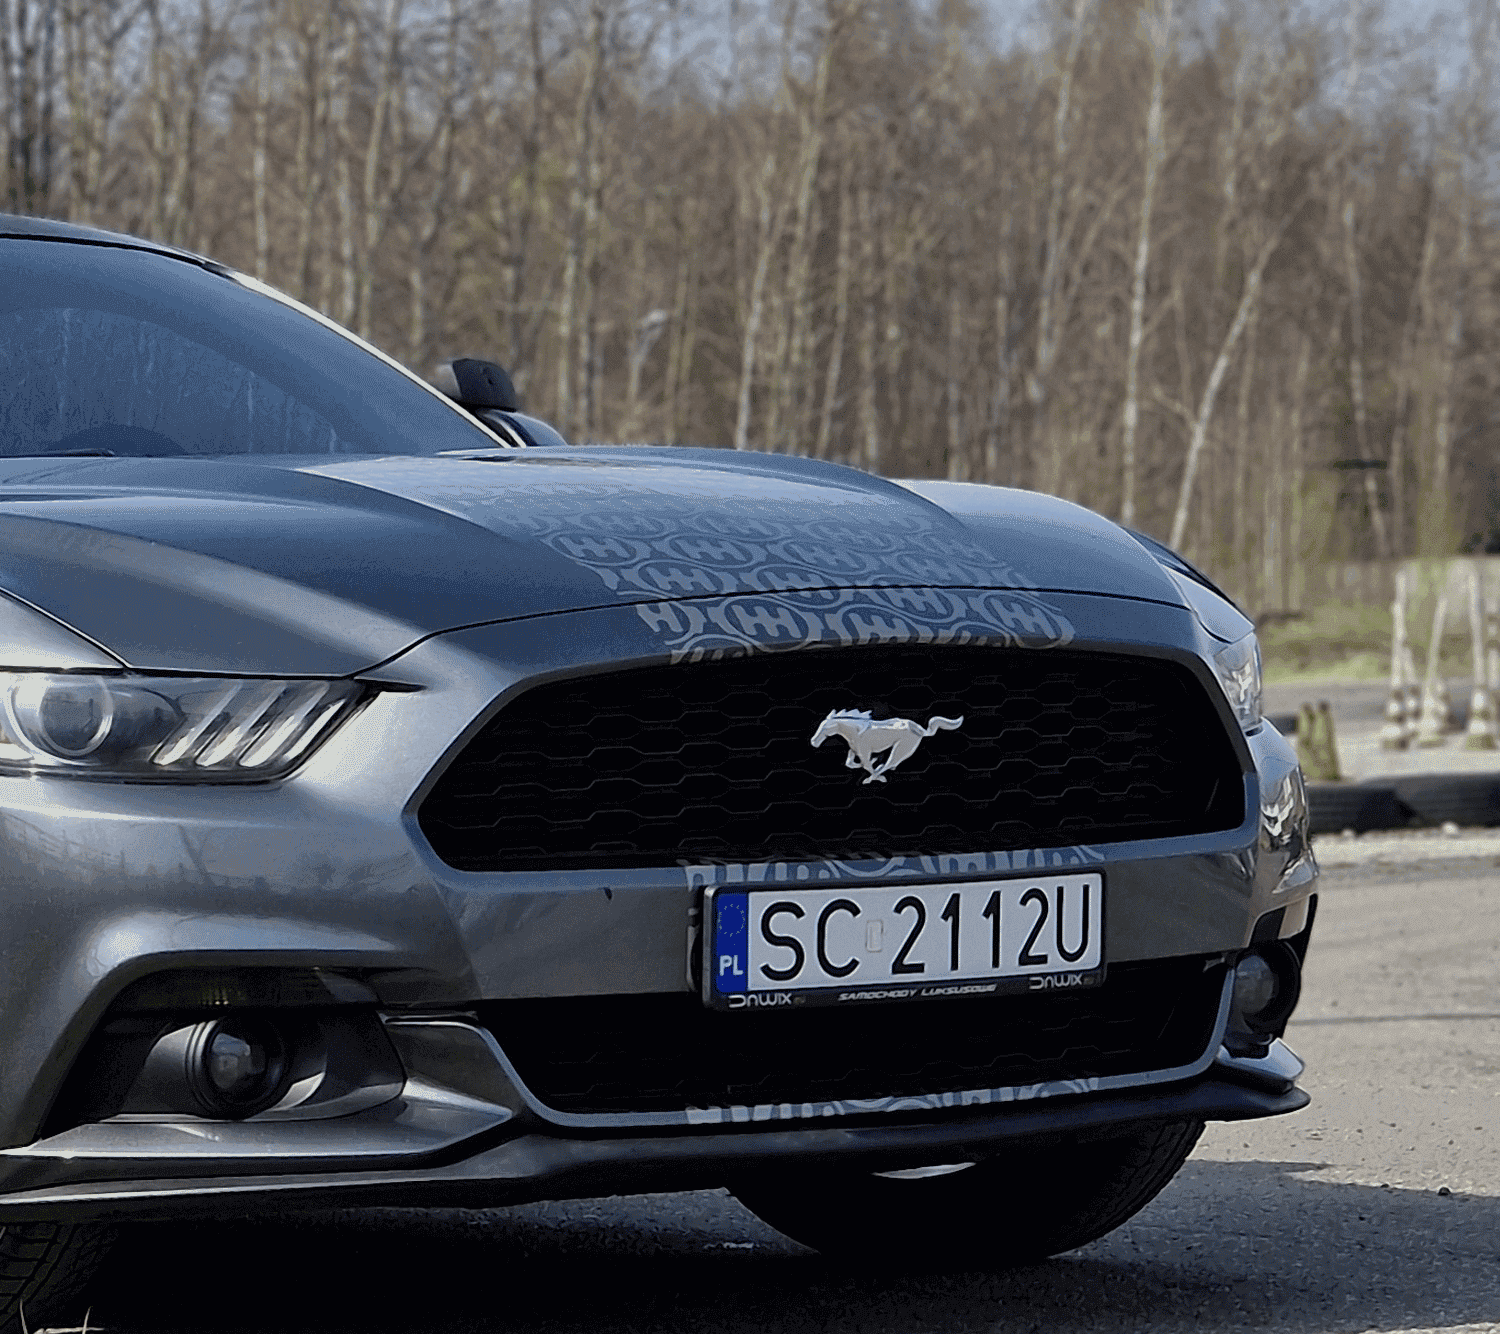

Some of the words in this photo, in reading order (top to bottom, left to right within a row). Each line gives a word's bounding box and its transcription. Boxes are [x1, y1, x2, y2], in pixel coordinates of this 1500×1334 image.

[759, 898, 862, 982] SC
[890, 883, 1092, 975] 2112U
[719, 954, 744, 976] PL
